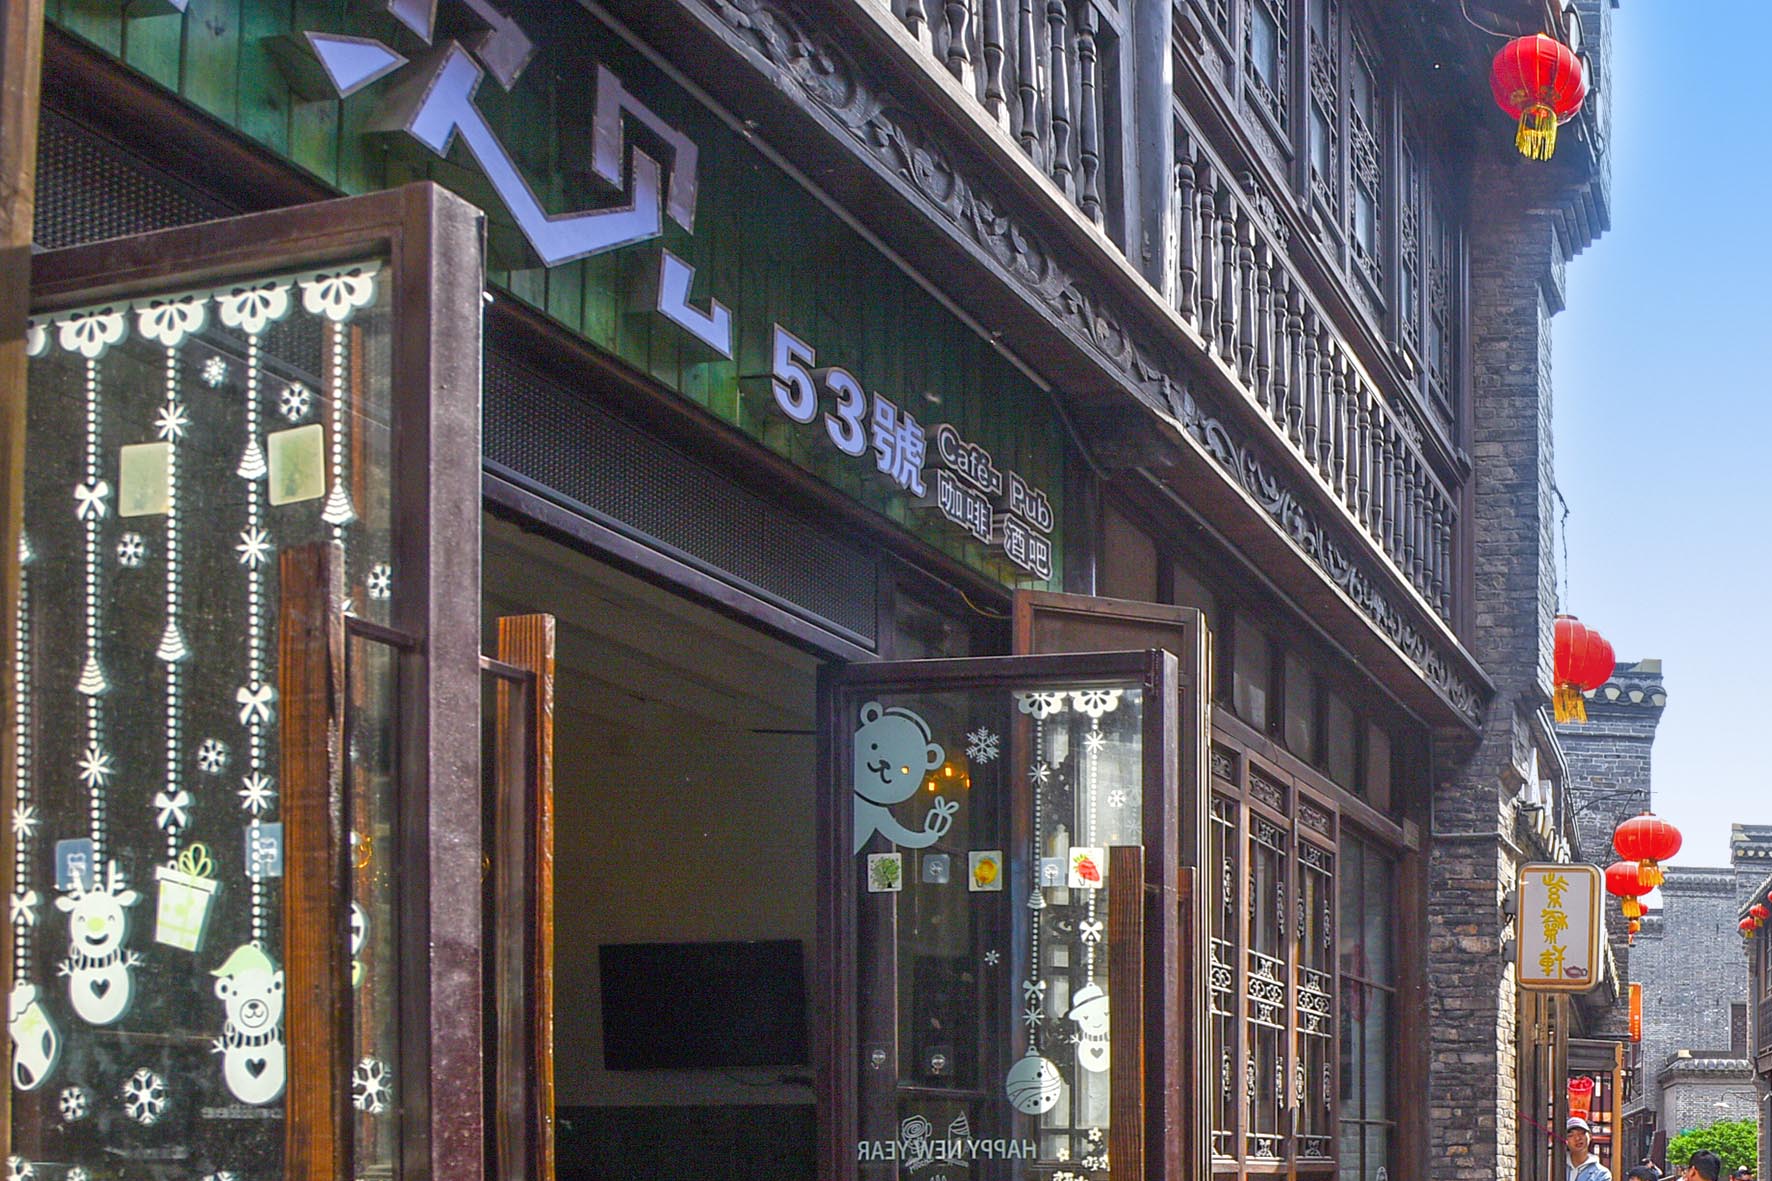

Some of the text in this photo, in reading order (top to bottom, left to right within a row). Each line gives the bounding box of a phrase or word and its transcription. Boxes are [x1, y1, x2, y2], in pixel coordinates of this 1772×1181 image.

[772, 322, 926, 498] 53號
[939, 473, 1050, 576] 咖啡 酒吧
[1011, 475, 1053, 530] Pub
